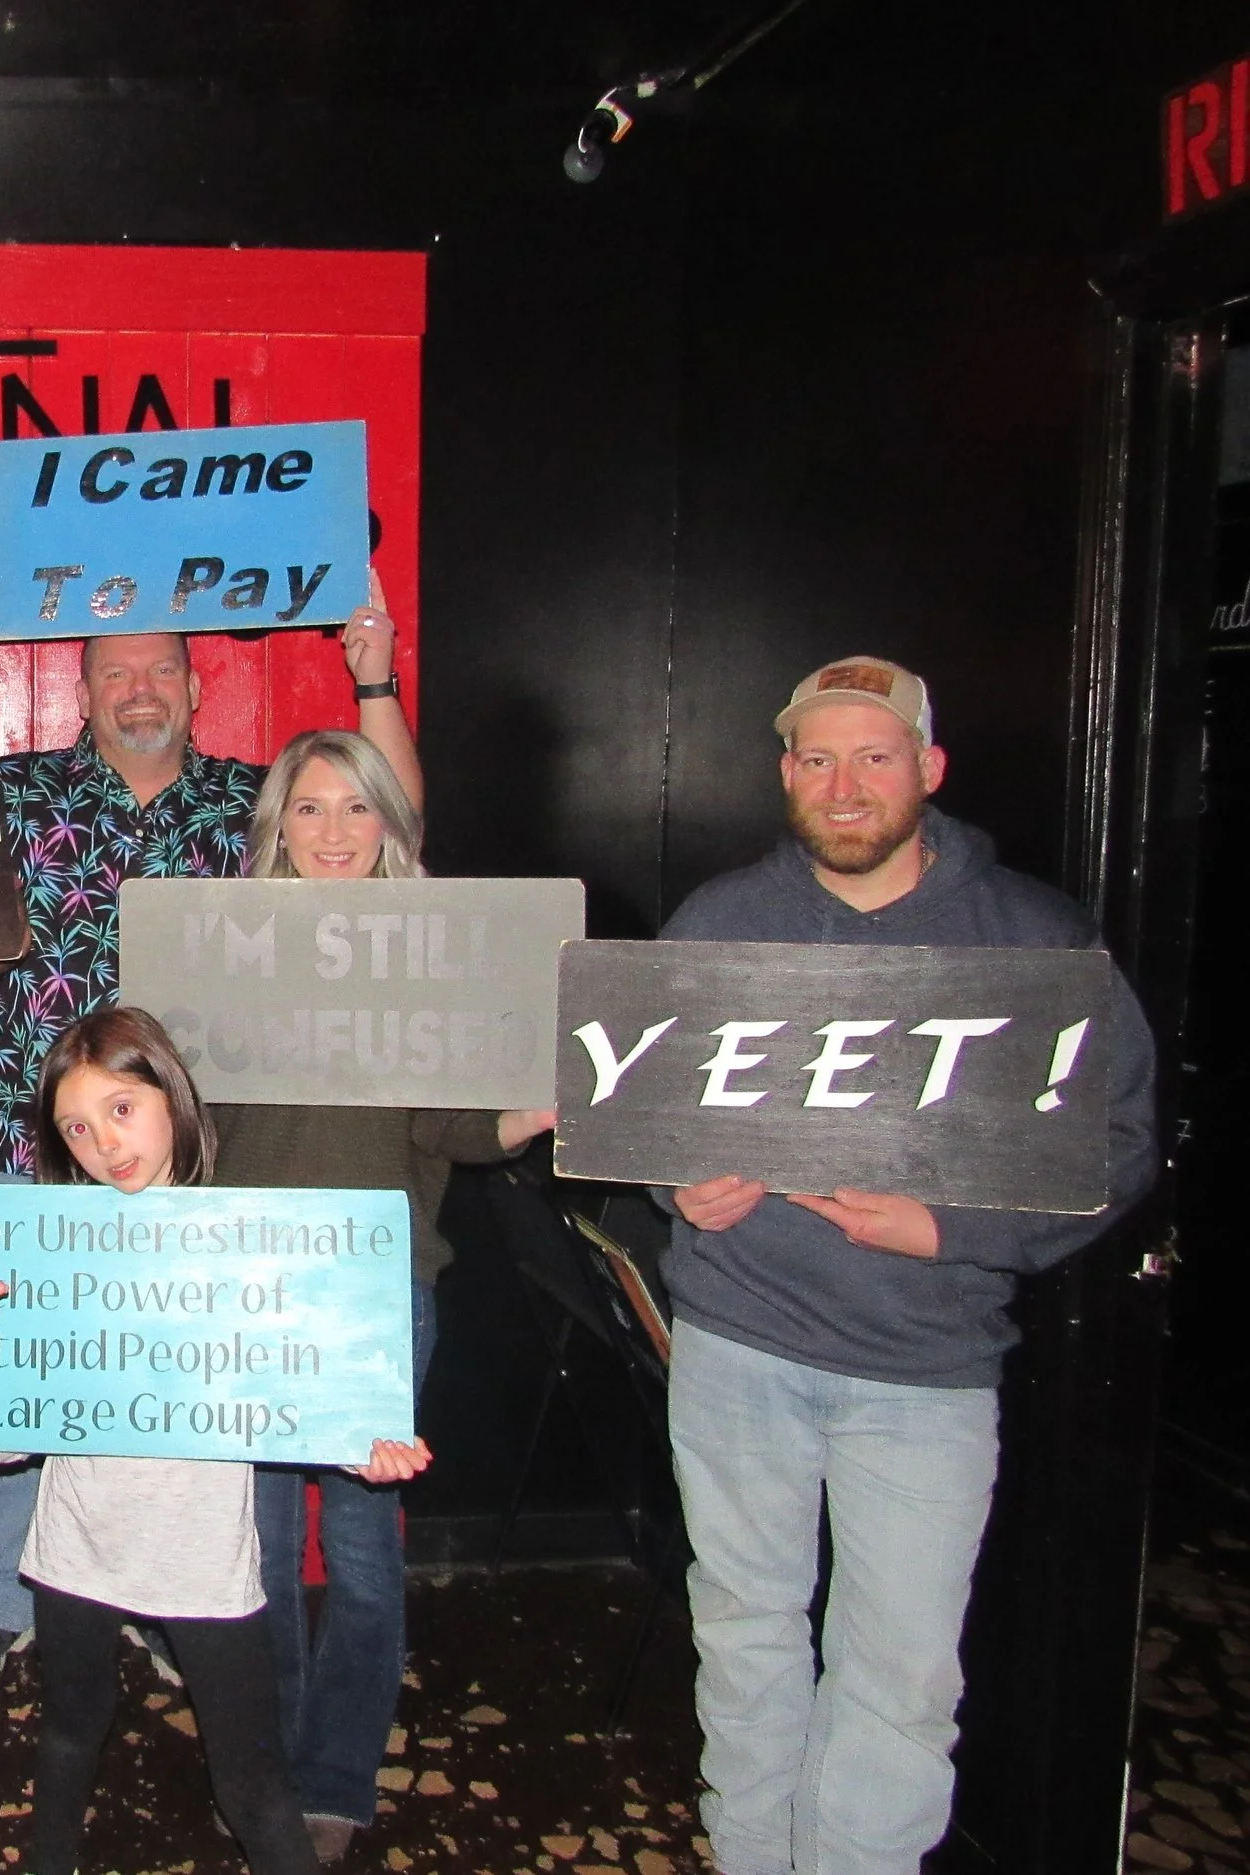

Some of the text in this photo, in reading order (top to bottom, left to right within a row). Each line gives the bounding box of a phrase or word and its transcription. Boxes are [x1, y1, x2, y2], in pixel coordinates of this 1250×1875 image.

[31, 451, 61, 508] I
[78, 446, 313, 504] Came
[32, 556, 332, 623] To Pay
[182, 912, 502, 981] I'M STILL
[159, 1007, 539, 1077] CONFUSED
[37, 1212, 394, 1257] Underestimate
[72, 1272, 229, 1315] Power
[241, 1273, 293, 1315] of
[119, 1330, 270, 1385] People
[281, 1334, 321, 1376] in
[128, 1392, 299, 1447] Groups
